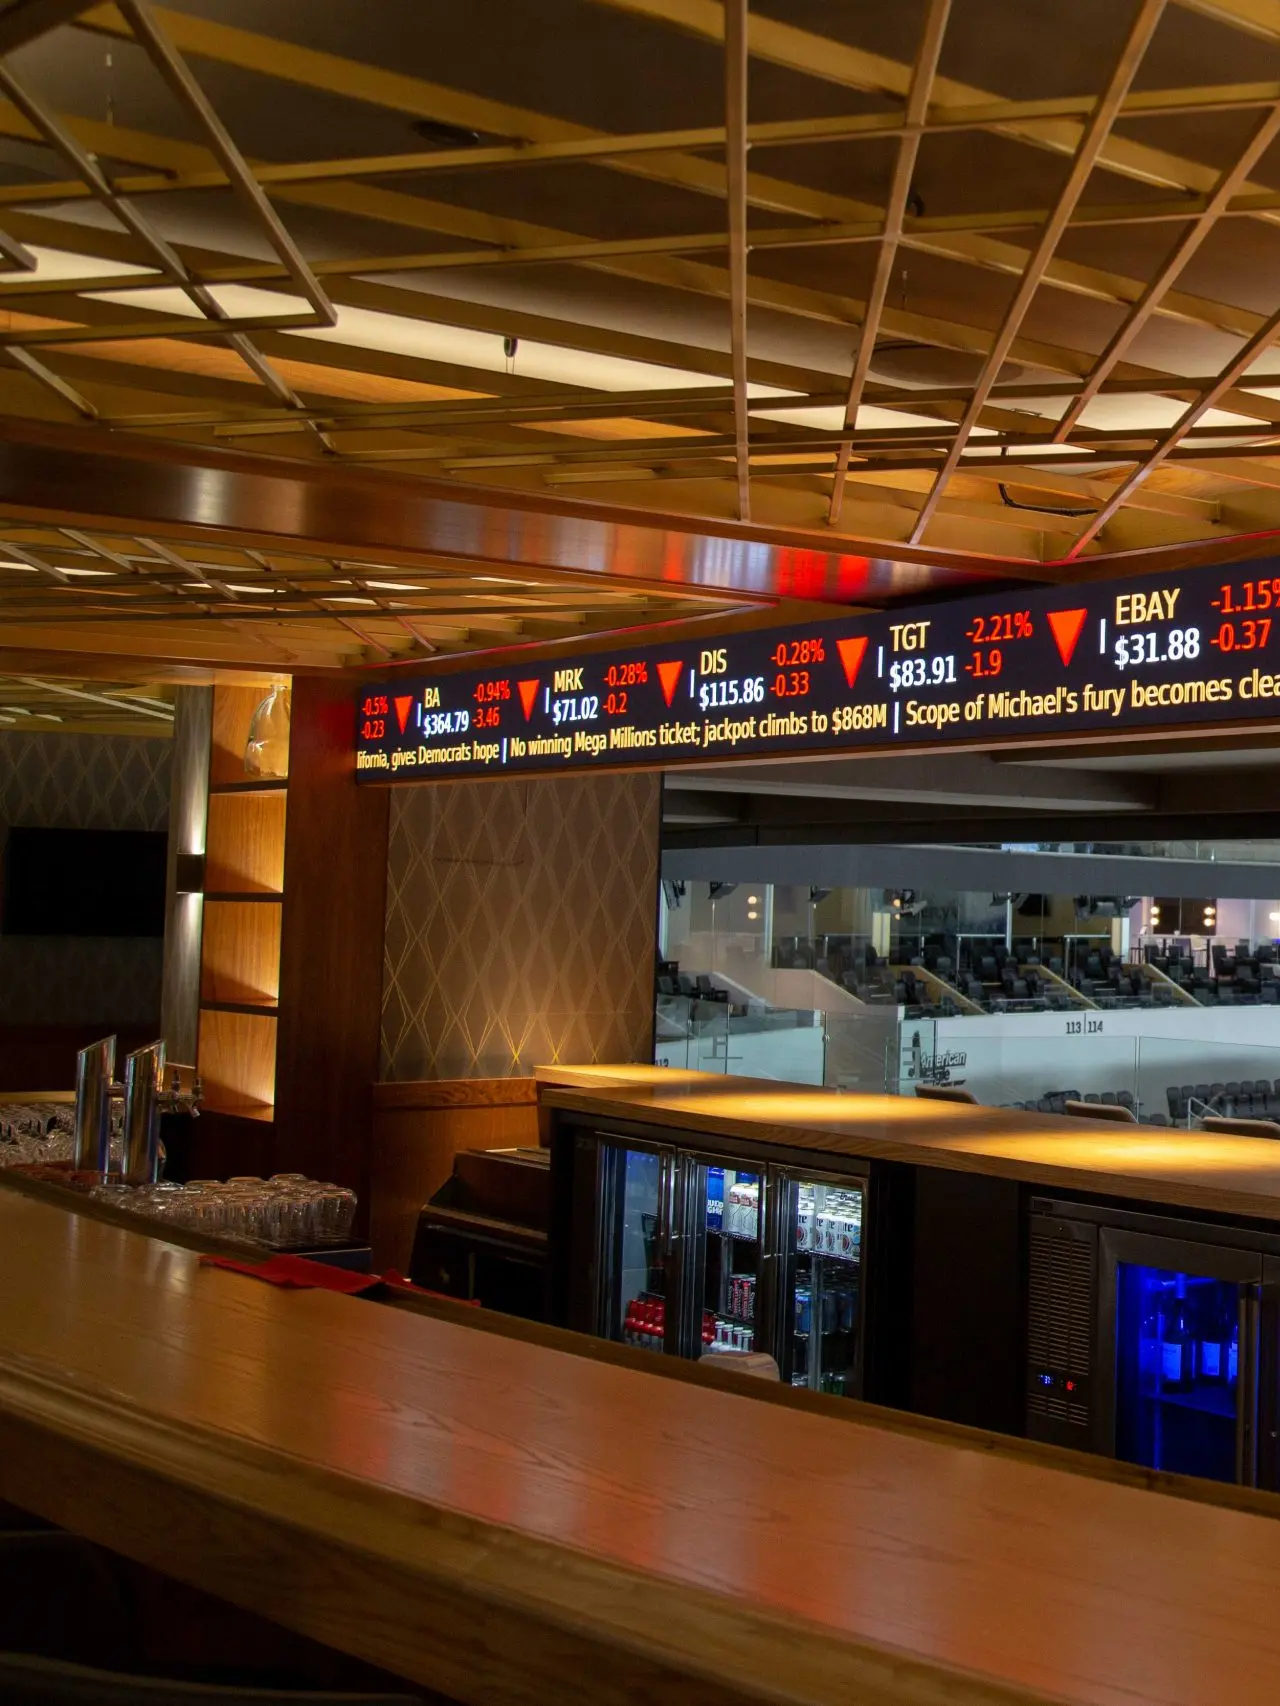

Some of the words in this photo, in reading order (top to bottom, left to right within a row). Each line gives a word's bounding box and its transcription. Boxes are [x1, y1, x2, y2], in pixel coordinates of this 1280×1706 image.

[1116, 588, 1180, 625] EBAY
[890, 622, 930, 651] TGT
[966, 611, 1033, 643] -2.21%
[1115, 628, 1200, 670] $31.88
[1210, 618, 1271, 652] -0.37
[700, 649, 727, 675] DIS
[771, 638, 825, 666] -0.28%
[889, 655, 956, 692] $83.91
[965, 649, 1002, 676] -1.9
[425, 688, 440, 708] BA
[473, 680, 510, 702] -0.94%
[554, 668, 583, 692] MRK
[604, 662, 648, 687] -0.28%
[699, 677, 764, 711] $115.86
[770, 671, 809, 697] -0.33
[362, 696, 388, 716] -0.5%
[552, 696, 598, 725] $71.02
[603, 692, 627, 714] -0.2
[906, 701, 960, 729] Scope
[965, 694, 984, 720] of
[988, 687, 1078, 718] Michael's
[1083, 684, 1126, 716] fury
[1131, 679, 1232, 707] becomes
[361, 720, 384, 739] -0.23
[422, 711, 469, 738] $364.79
[472, 706, 500, 728] -3.46
[510, 737, 526, 757] No
[528, 733, 572, 758] winning
[575, 731, 606, 756] Mega
[610, 726, 656, 749] Millions
[659, 722, 700, 745] ticket;
[703, 717, 756, 747] jackpot
[759, 712, 807, 737] climbs
[811, 711, 827, 732] to
[832, 704, 886, 735] $868M
[391, 748, 416, 771] gives
[418, 743, 471, 764] Democrats
[473, 741, 499, 764] hope
[1066, 1022, 1081, 1034] 113
[1087, 1020, 1103, 1033] 114
